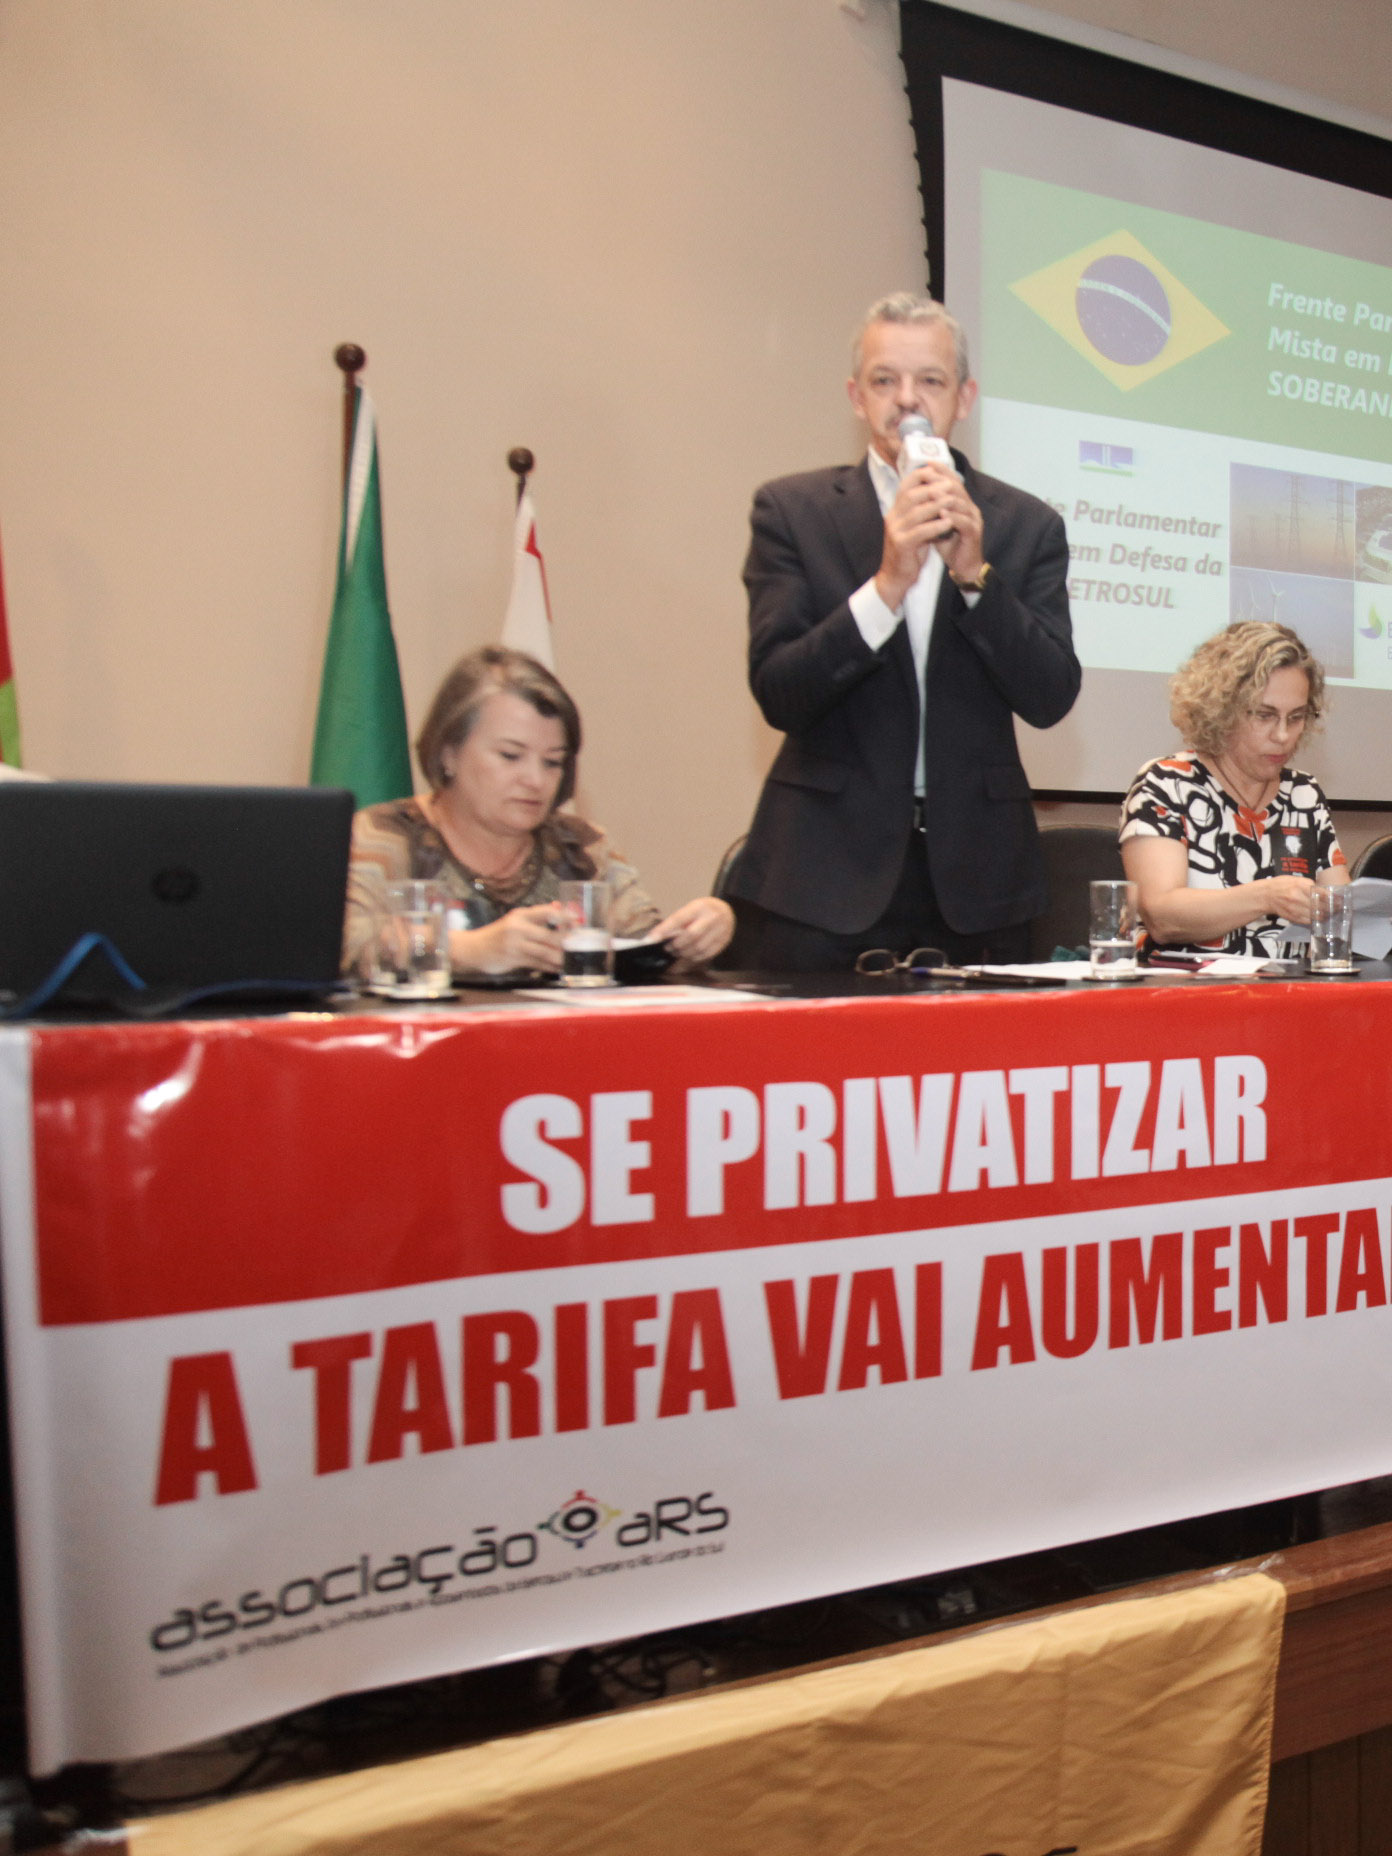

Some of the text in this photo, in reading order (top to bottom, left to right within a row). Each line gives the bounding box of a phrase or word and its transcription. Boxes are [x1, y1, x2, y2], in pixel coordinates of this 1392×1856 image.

[1268, 282, 1347, 323] Frente
[1267, 326, 1337, 364] Mista
[1344, 348, 1381, 373] em
[1073, 499, 1222, 538] Parlamentar
[1069, 542, 1223, 576] em Defesa da
[1068, 577, 1176, 609] ETROSUL
[499, 1054, 1268, 1235] SE PRIVATIZAR
[153, 1352, 259, 1506] A
[291, 1287, 737, 1477] TARIFA
[764, 1261, 942, 1401] VAI
[616, 1491, 729, 1548] aRS
